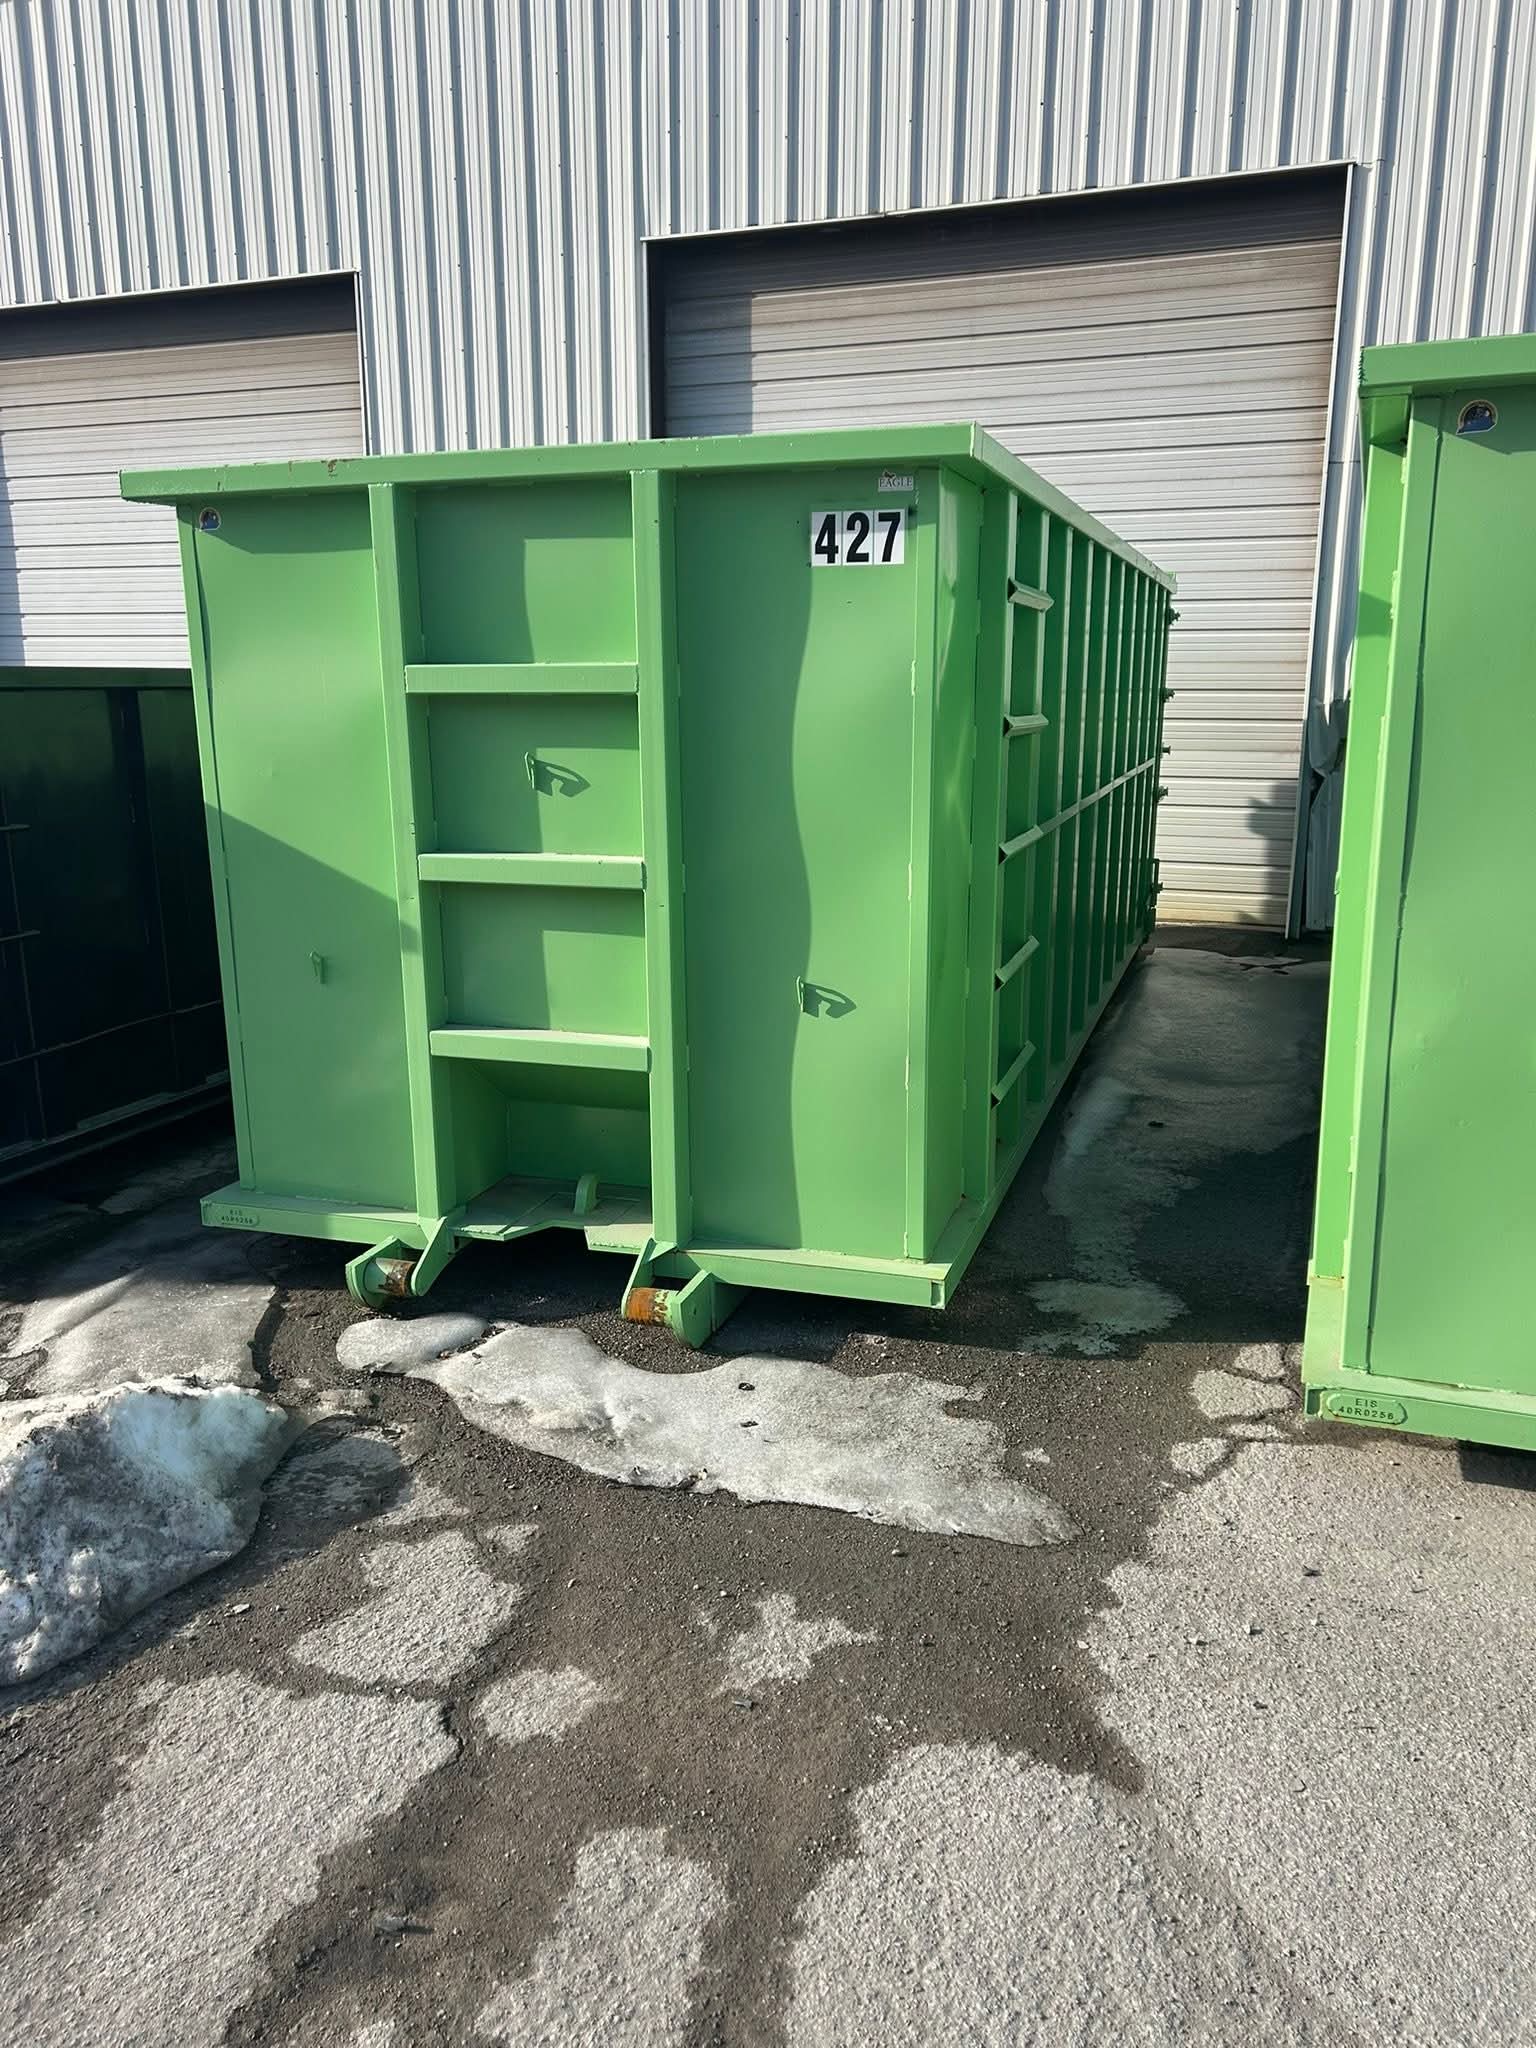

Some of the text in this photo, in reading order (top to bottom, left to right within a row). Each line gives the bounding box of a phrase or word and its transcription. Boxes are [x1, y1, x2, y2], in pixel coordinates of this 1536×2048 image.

[880, 477, 912, 488] EAGLE
[815, 511, 901, 564] 427
[1355, 1398, 1377, 1408] EIS
